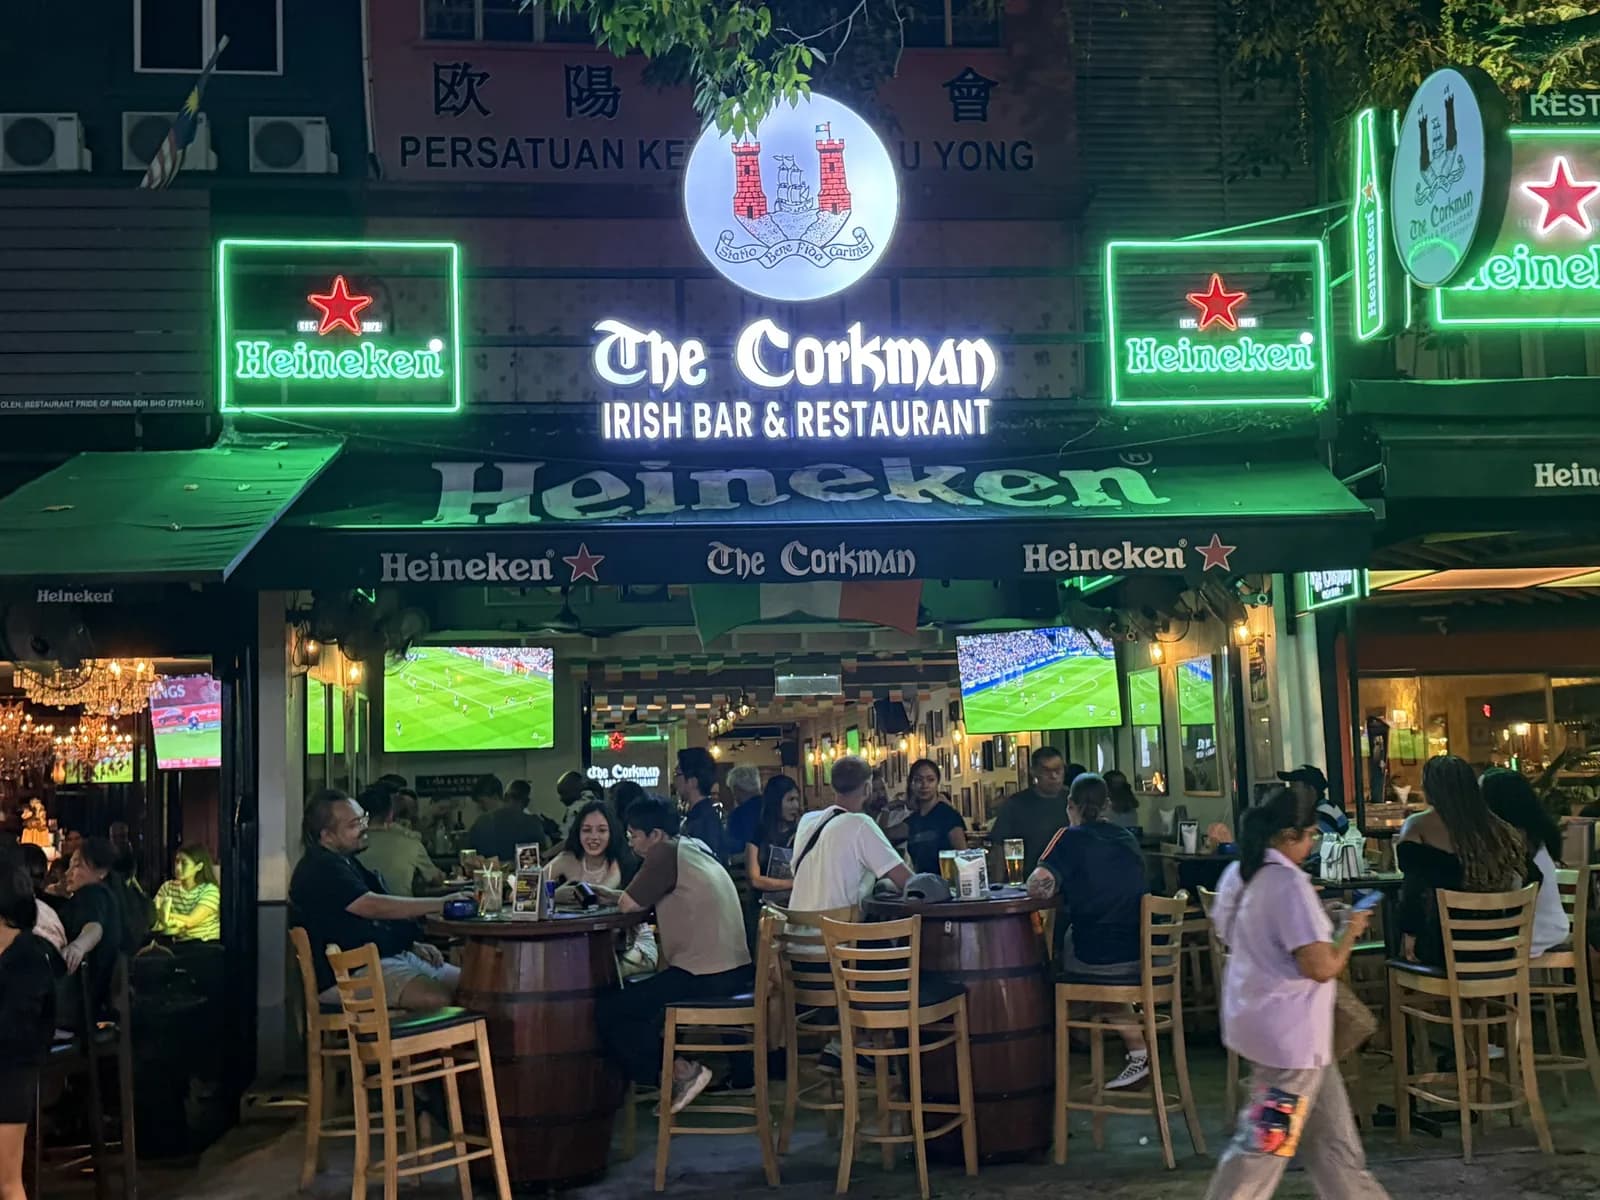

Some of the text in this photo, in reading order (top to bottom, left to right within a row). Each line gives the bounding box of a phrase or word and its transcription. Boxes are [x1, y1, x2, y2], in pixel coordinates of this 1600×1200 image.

[564, 64, 622, 119] 陽
[942, 67, 999, 122] 會
[401, 137, 624, 169] PERSATUAN
[934, 141, 1034, 171] YONG
[1430, 189, 1473, 228] Corkman
[719, 246, 757, 261] Statio
[767, 243, 793, 265] Bene
[1365, 210, 1377, 320] Heineken
[236, 341, 444, 378] Heineken
[592, 318, 997, 392] The Corkman
[1126, 337, 1314, 374] Heineken
[99, 399, 110, 408] OF
[603, 398, 991, 440] IRISH BAR & RESTAURANT
[422, 456, 1171, 525] Heineken
[1533, 462, 1600, 487] Hein
[380, 540, 1187, 582] Heineken The Corkman Heineken
[36, 588, 114, 603] Heineken
